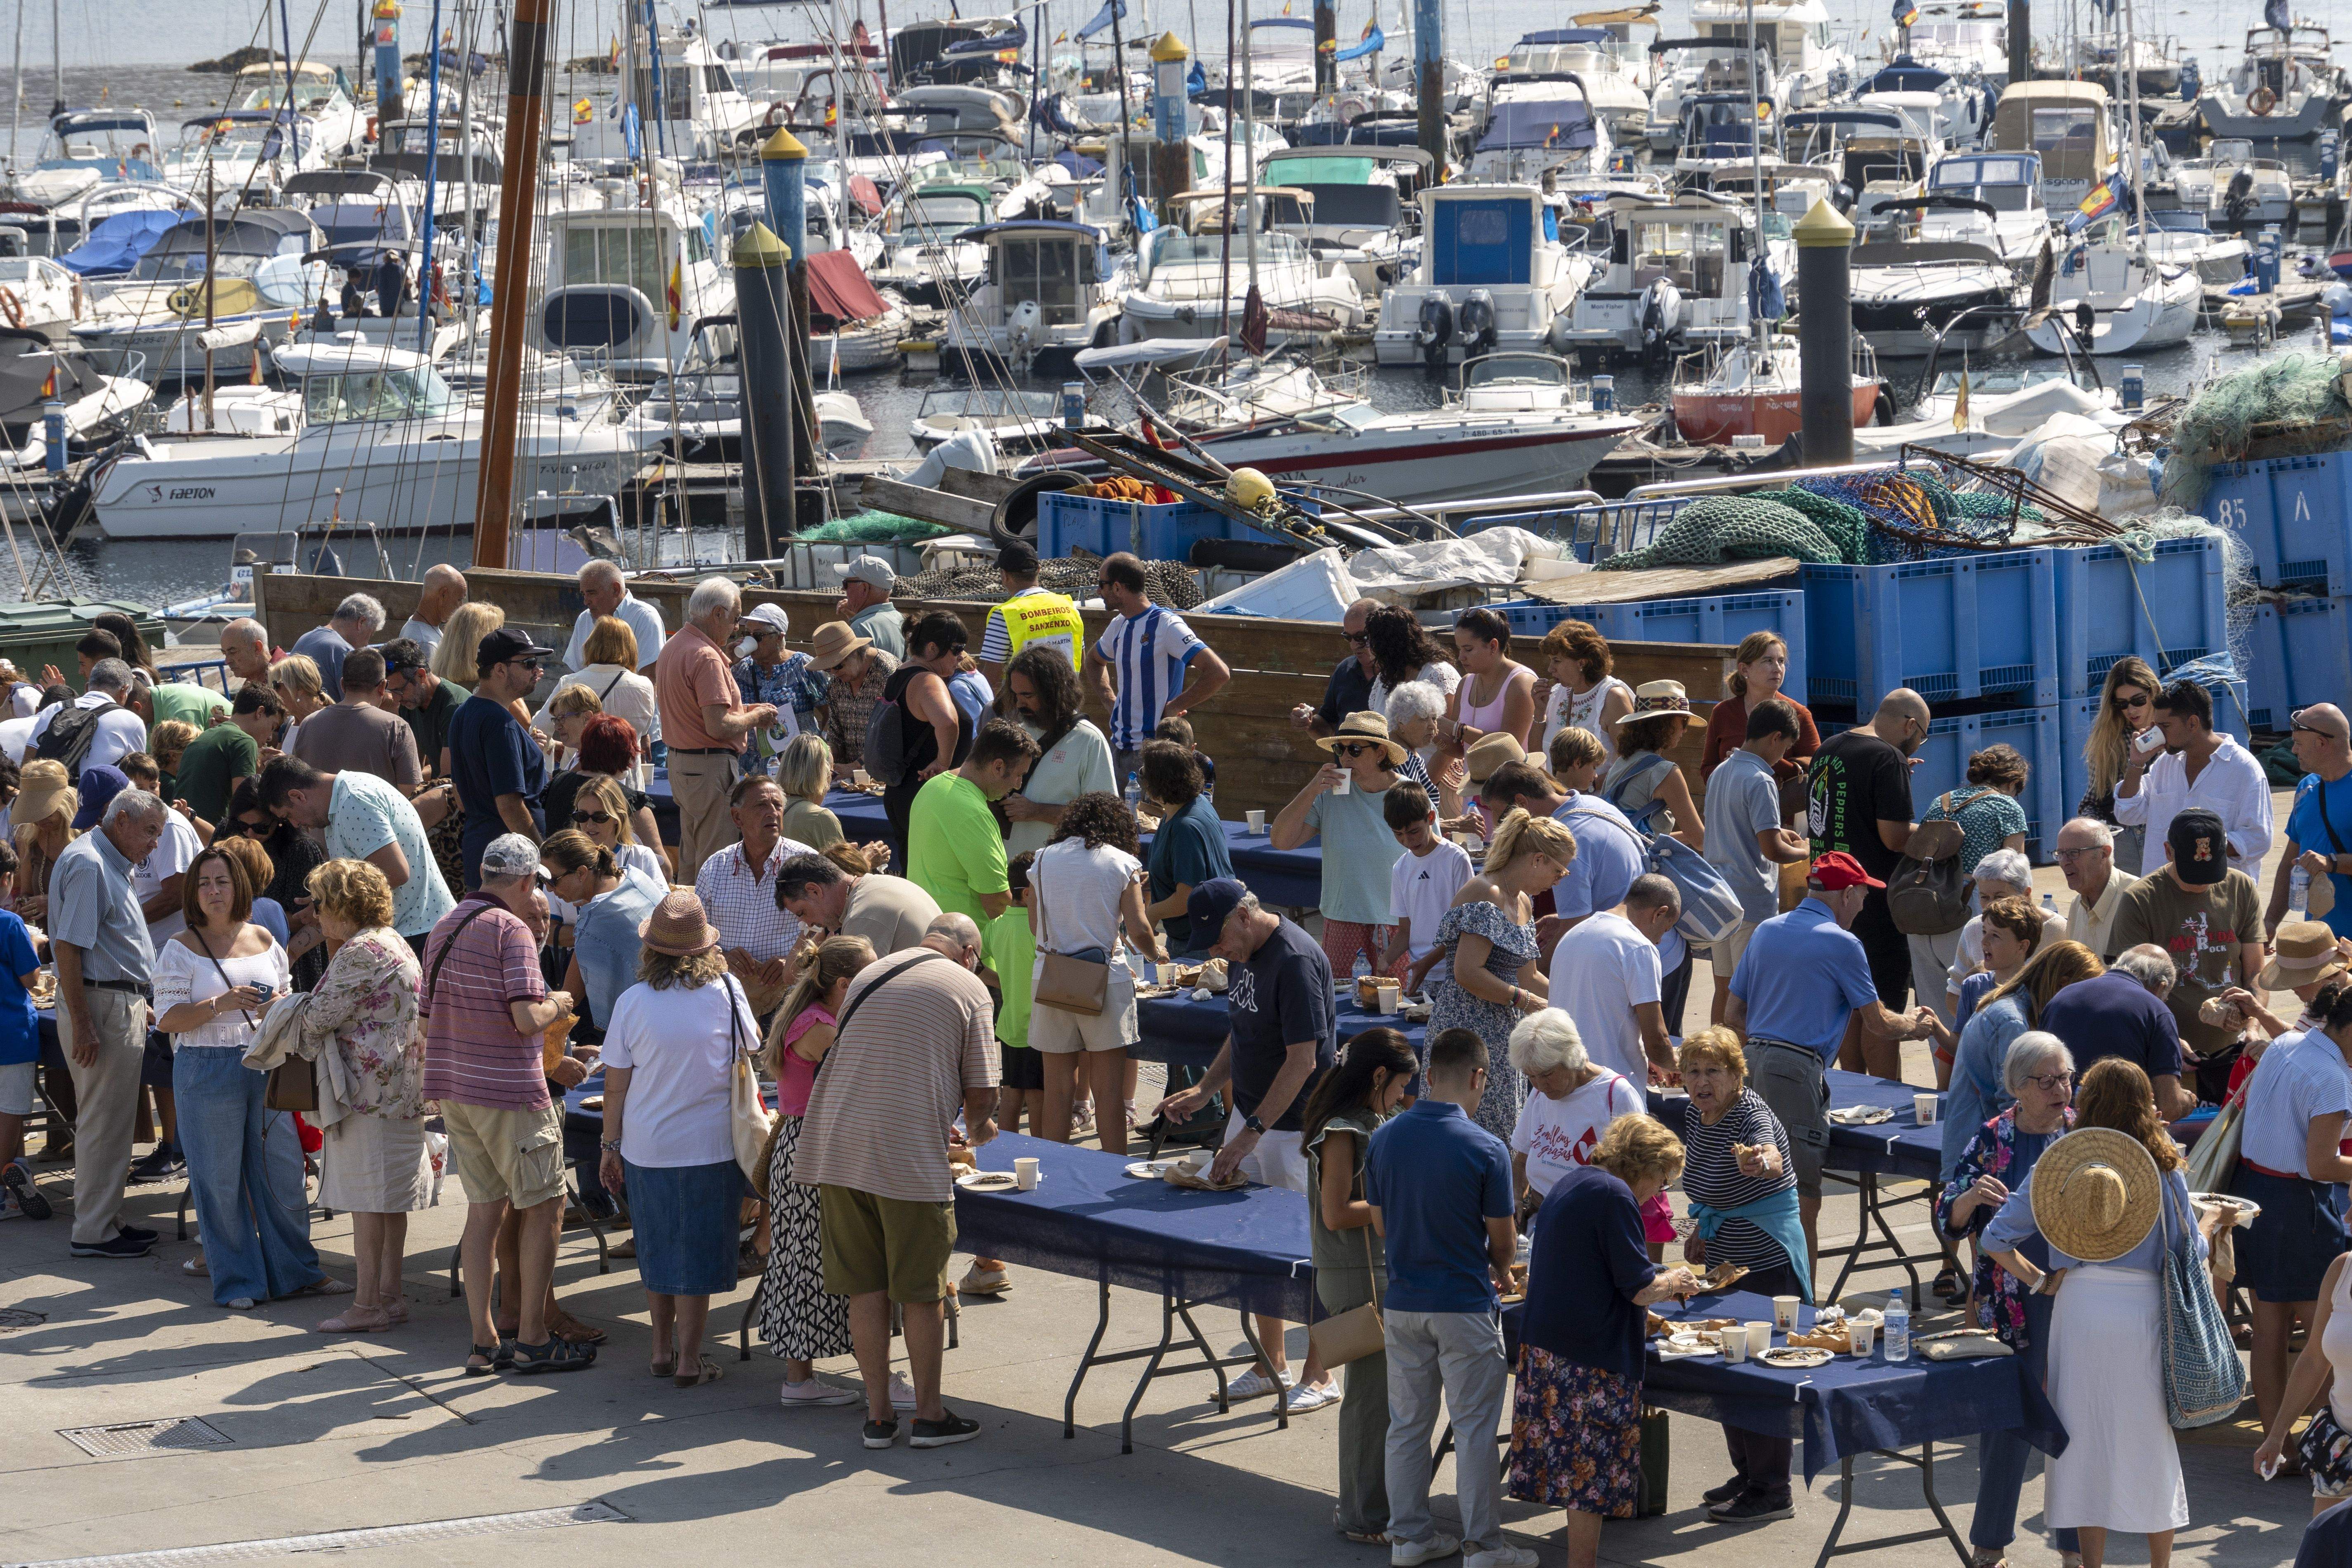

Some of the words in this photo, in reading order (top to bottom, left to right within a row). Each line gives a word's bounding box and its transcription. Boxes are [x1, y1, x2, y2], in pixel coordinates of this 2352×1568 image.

[2219, 498, 2247, 529] 85
[1020, 607, 1071, 621] BOMBEIROS
[1029, 619, 1070, 632] SANXENXO
[1831, 756, 1846, 775] HOT
[1835, 782, 1847, 837] PEPPERS
